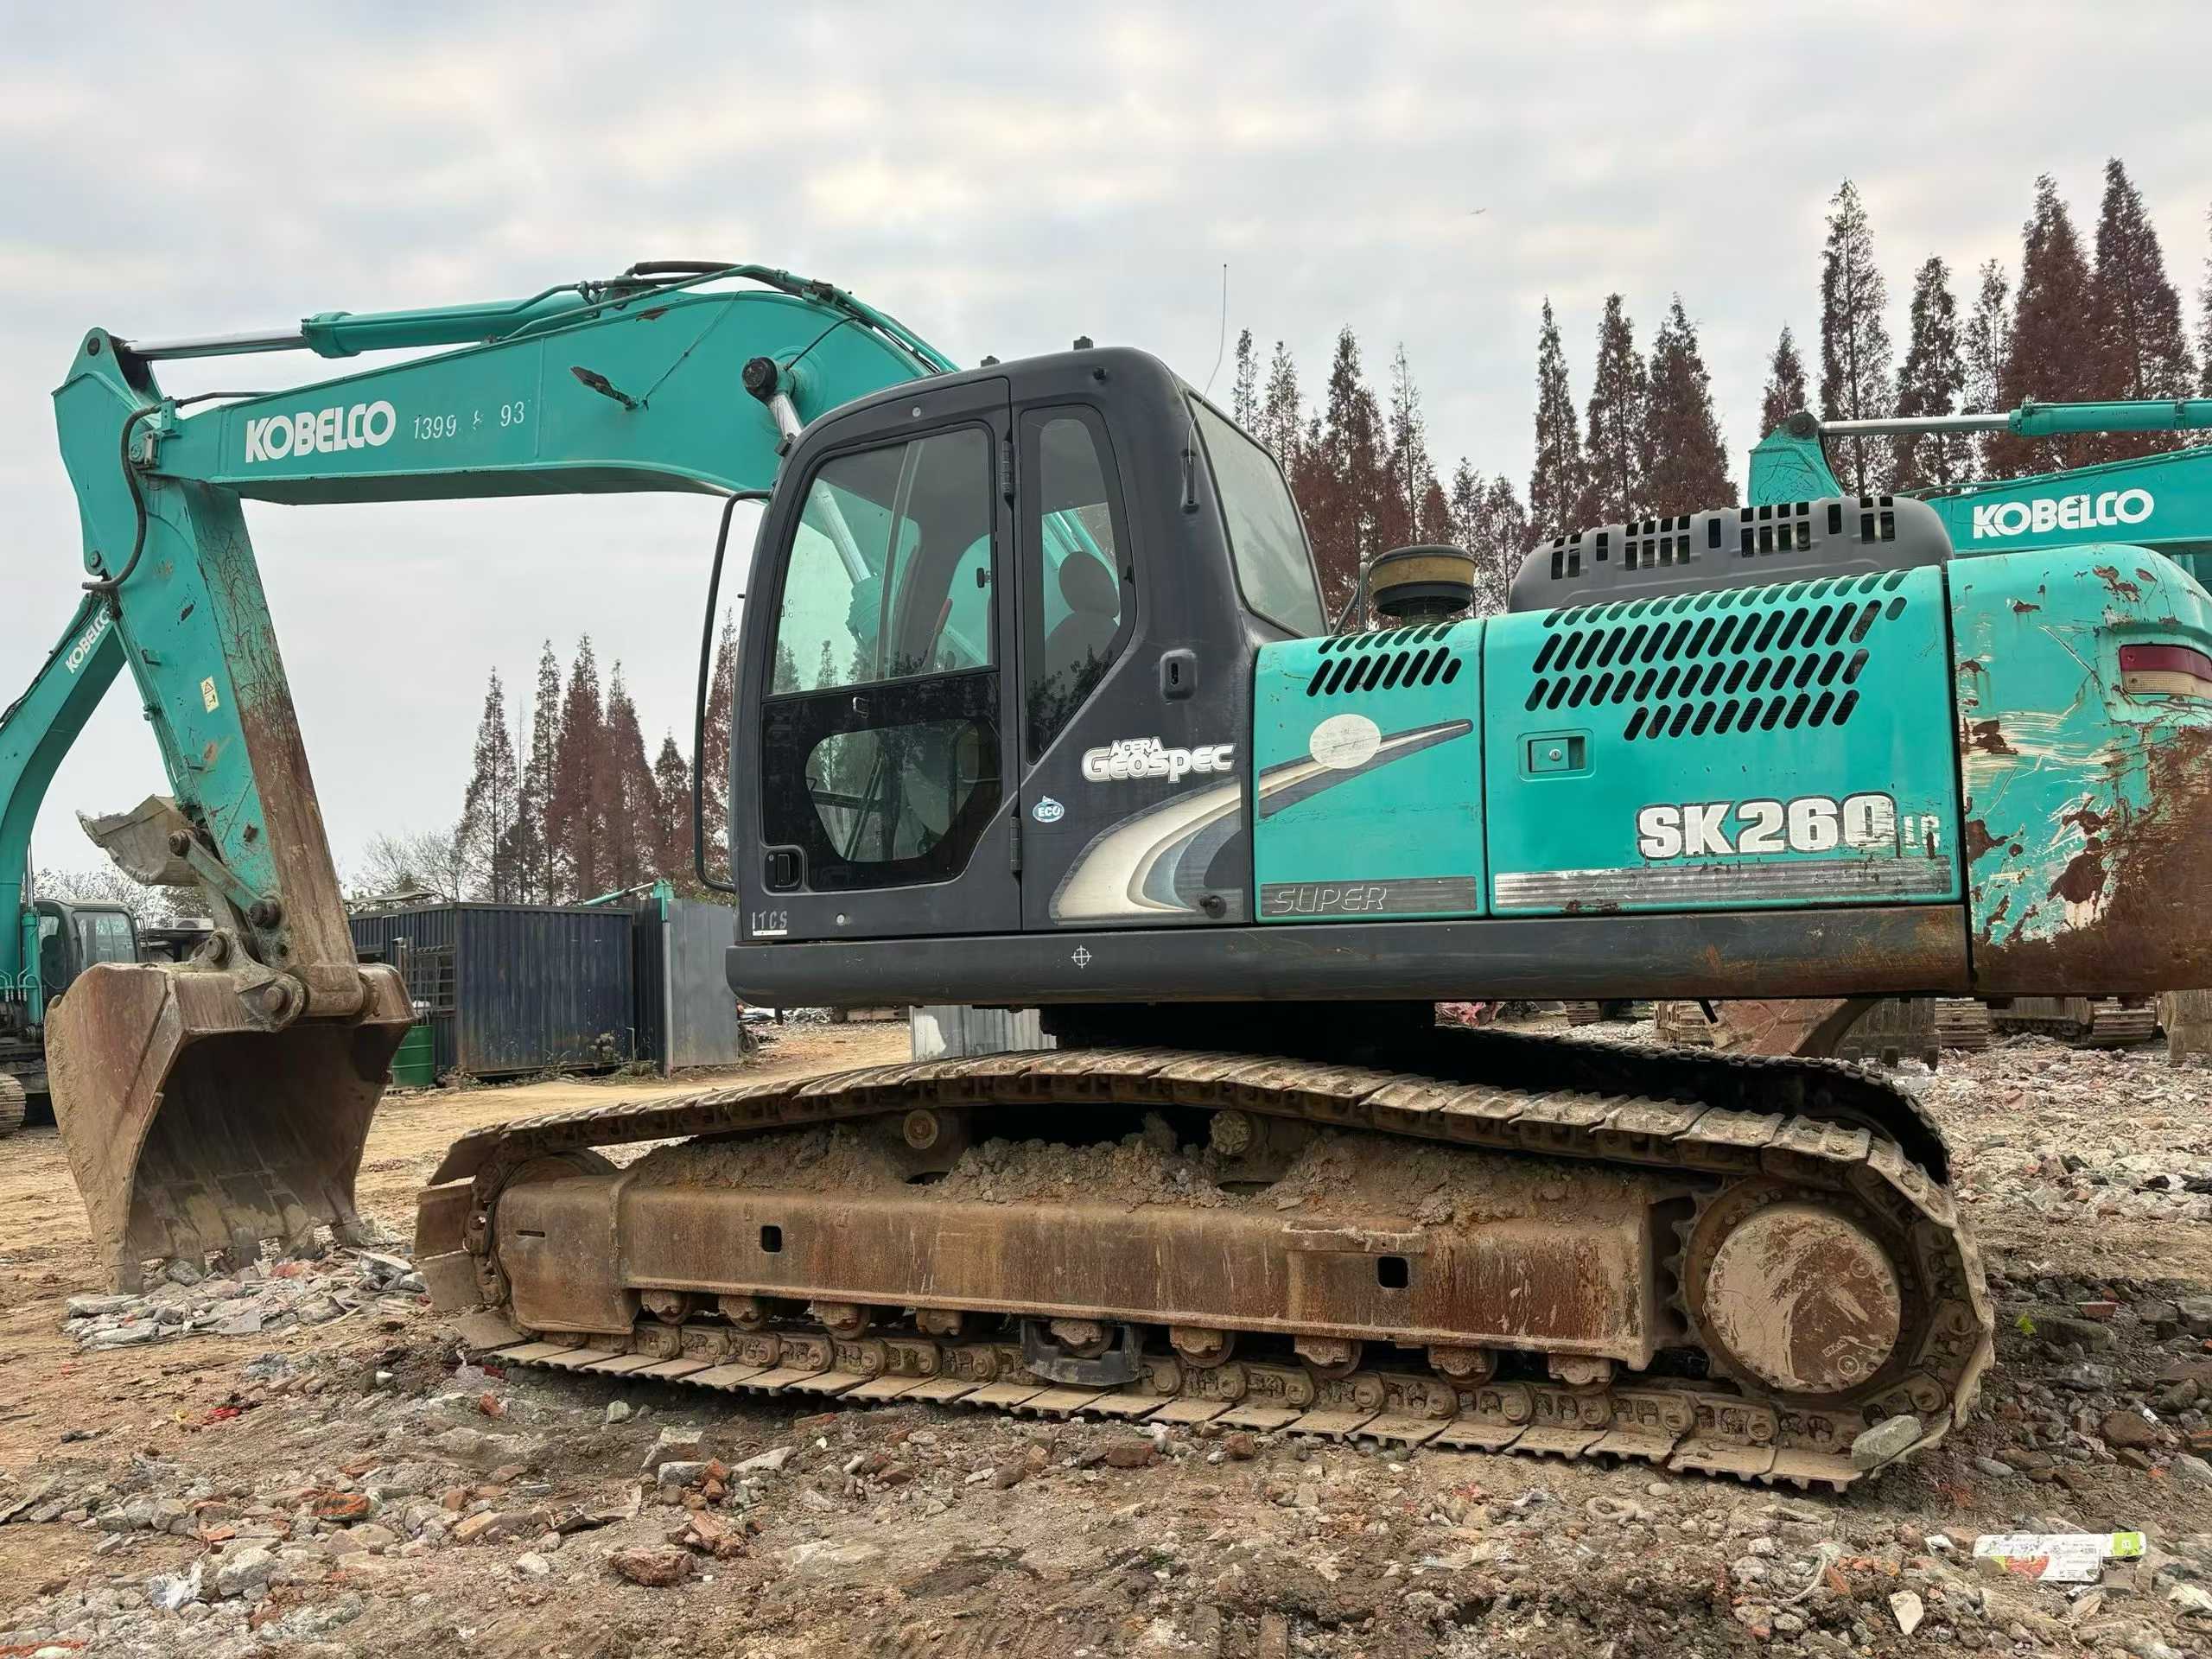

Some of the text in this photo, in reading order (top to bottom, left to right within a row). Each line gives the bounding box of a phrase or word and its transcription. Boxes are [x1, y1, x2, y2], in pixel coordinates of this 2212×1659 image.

[245, 400, 396, 463] KOBELCO
[414, 415, 456, 440] 1399
[500, 401, 524, 427] 93
[1974, 488, 2154, 539] KOBELCO
[1038, 805, 1061, 818] ECO
[1637, 791, 1897, 860] SK260
[1272, 886, 1387, 912] SUPER
